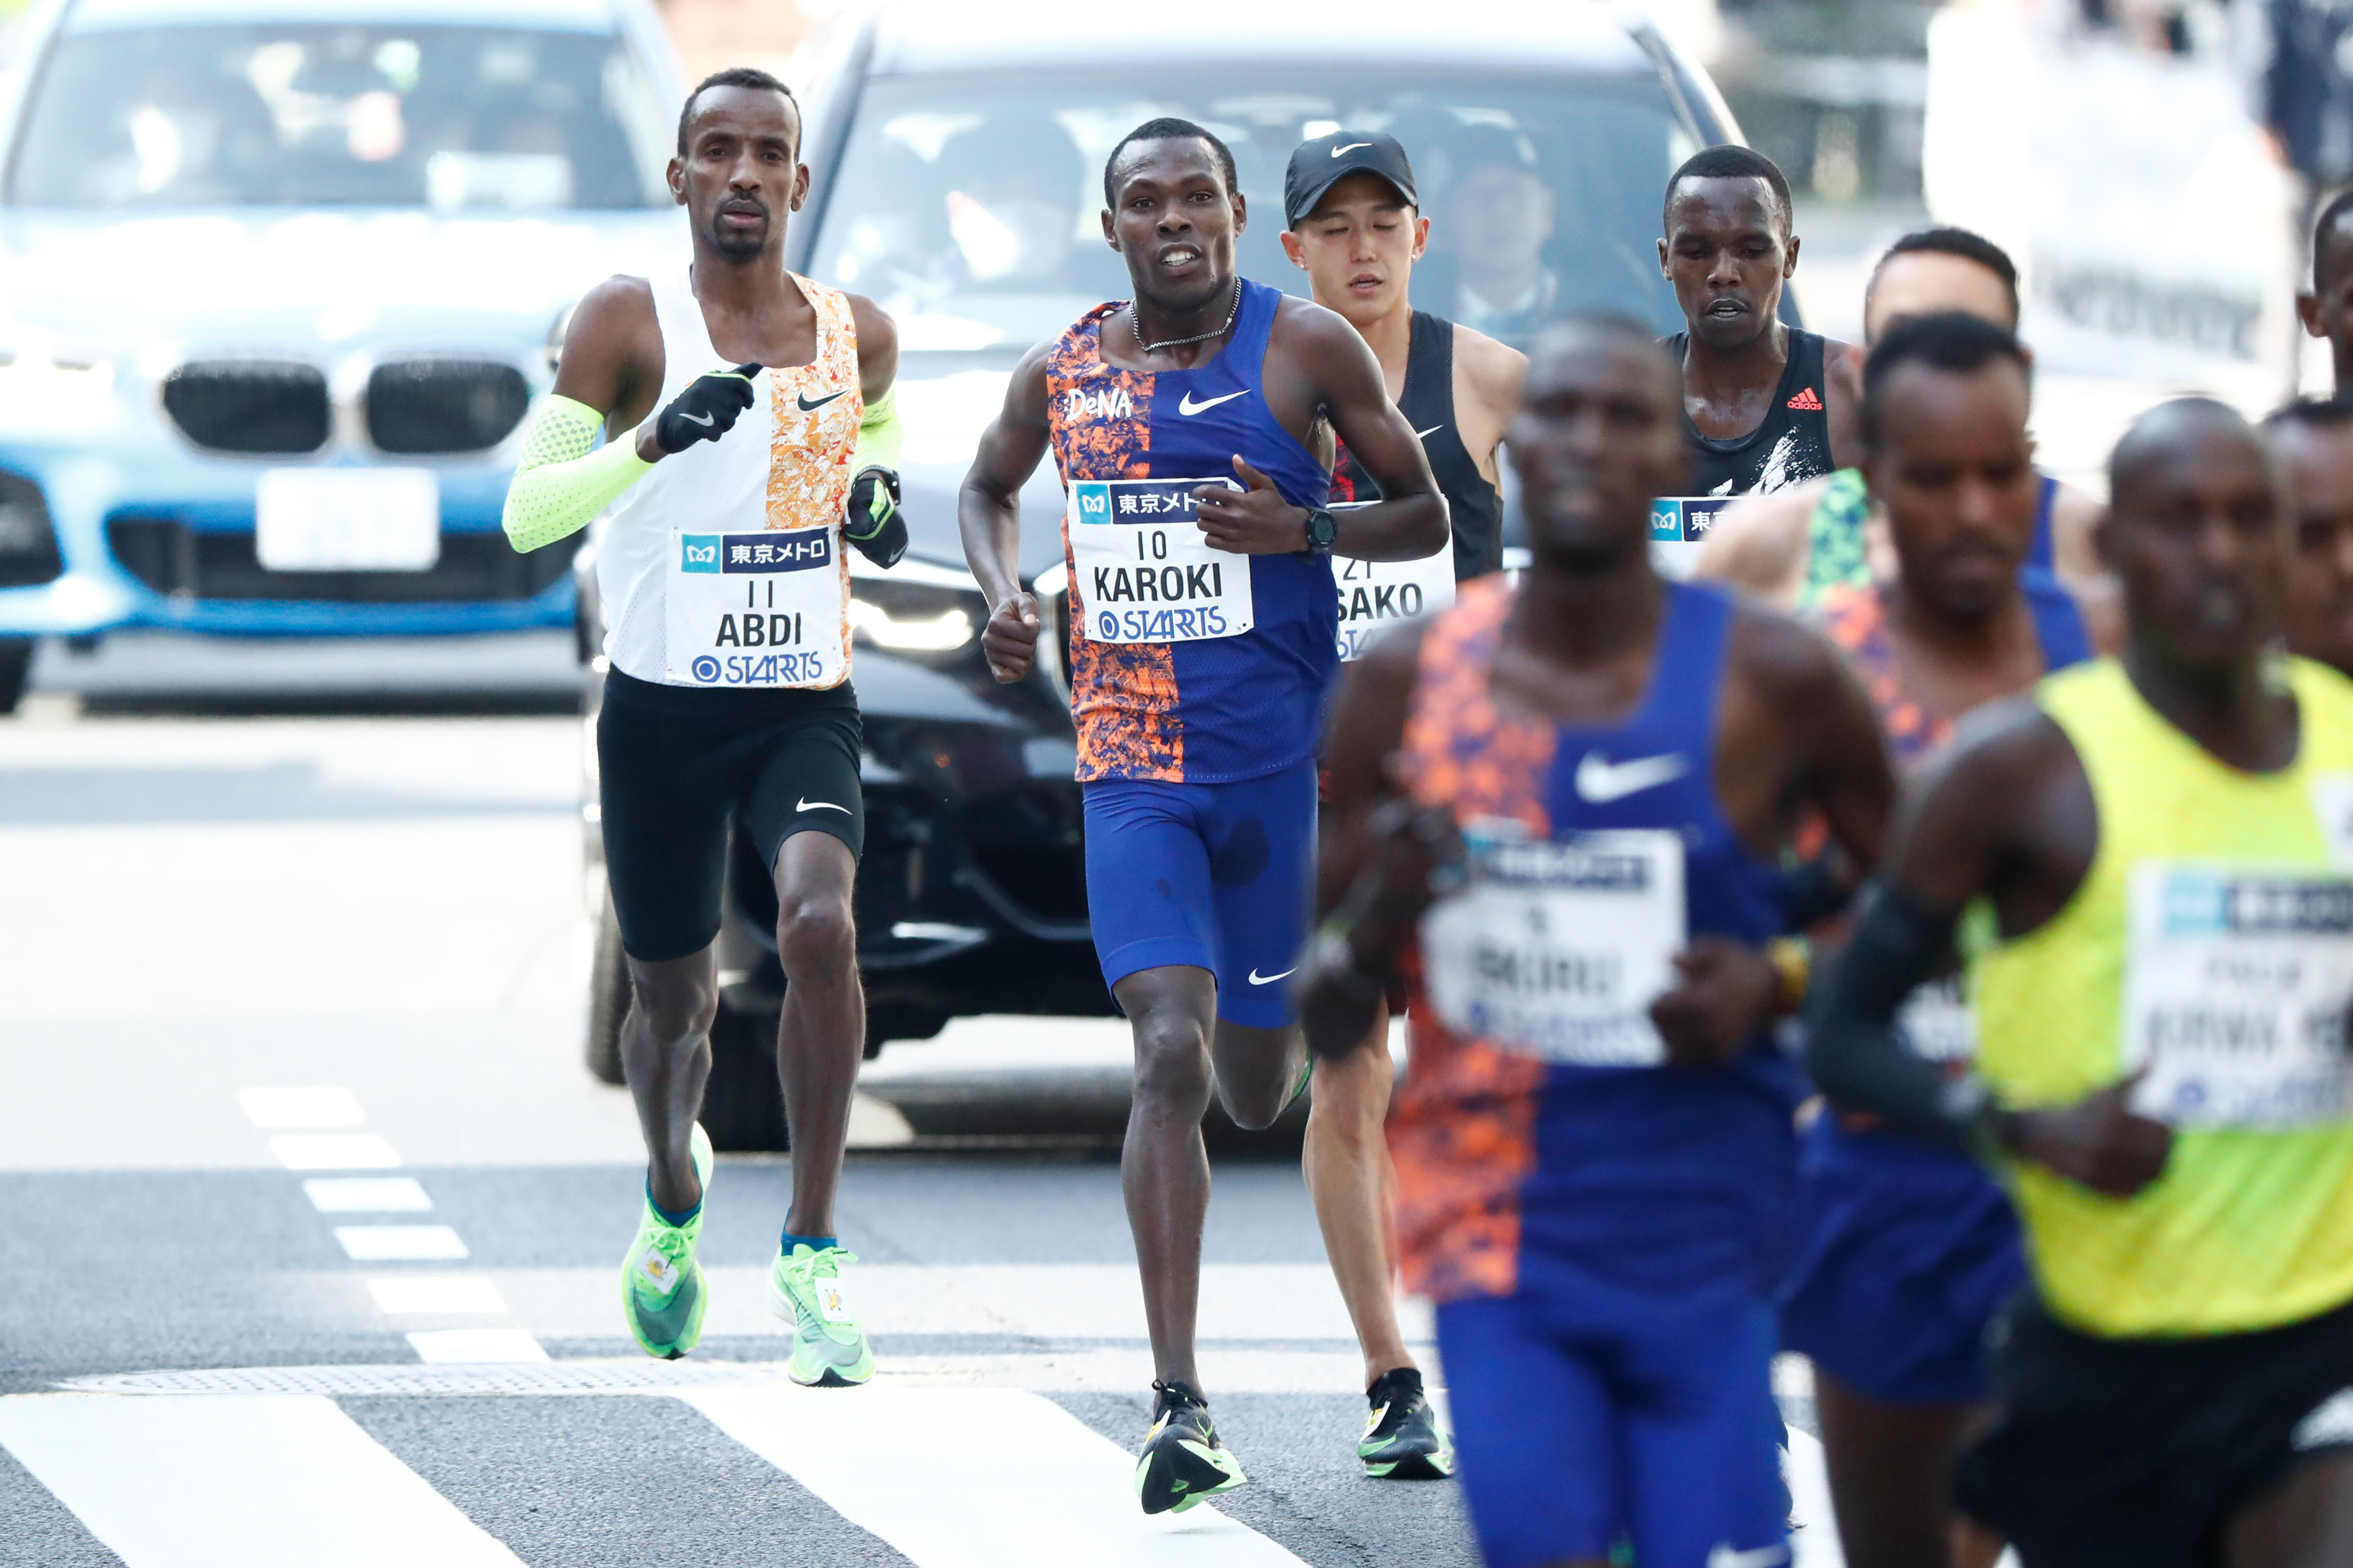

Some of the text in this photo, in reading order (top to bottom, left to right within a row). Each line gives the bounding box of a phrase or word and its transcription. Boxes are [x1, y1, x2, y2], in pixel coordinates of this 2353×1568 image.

[1787, 400, 1823, 410] adidas
[1118, 493, 1221, 515] 東京メト
[730, 539, 825, 563] 東京メトロ
[1138, 531, 1166, 560] 10
[749, 580, 773, 608] 11
[1095, 563, 1222, 602] KAROKI
[715, 612, 801, 647] ABDI
[1124, 606, 1226, 639] STARTS
[726, 651, 823, 683] STARTS
